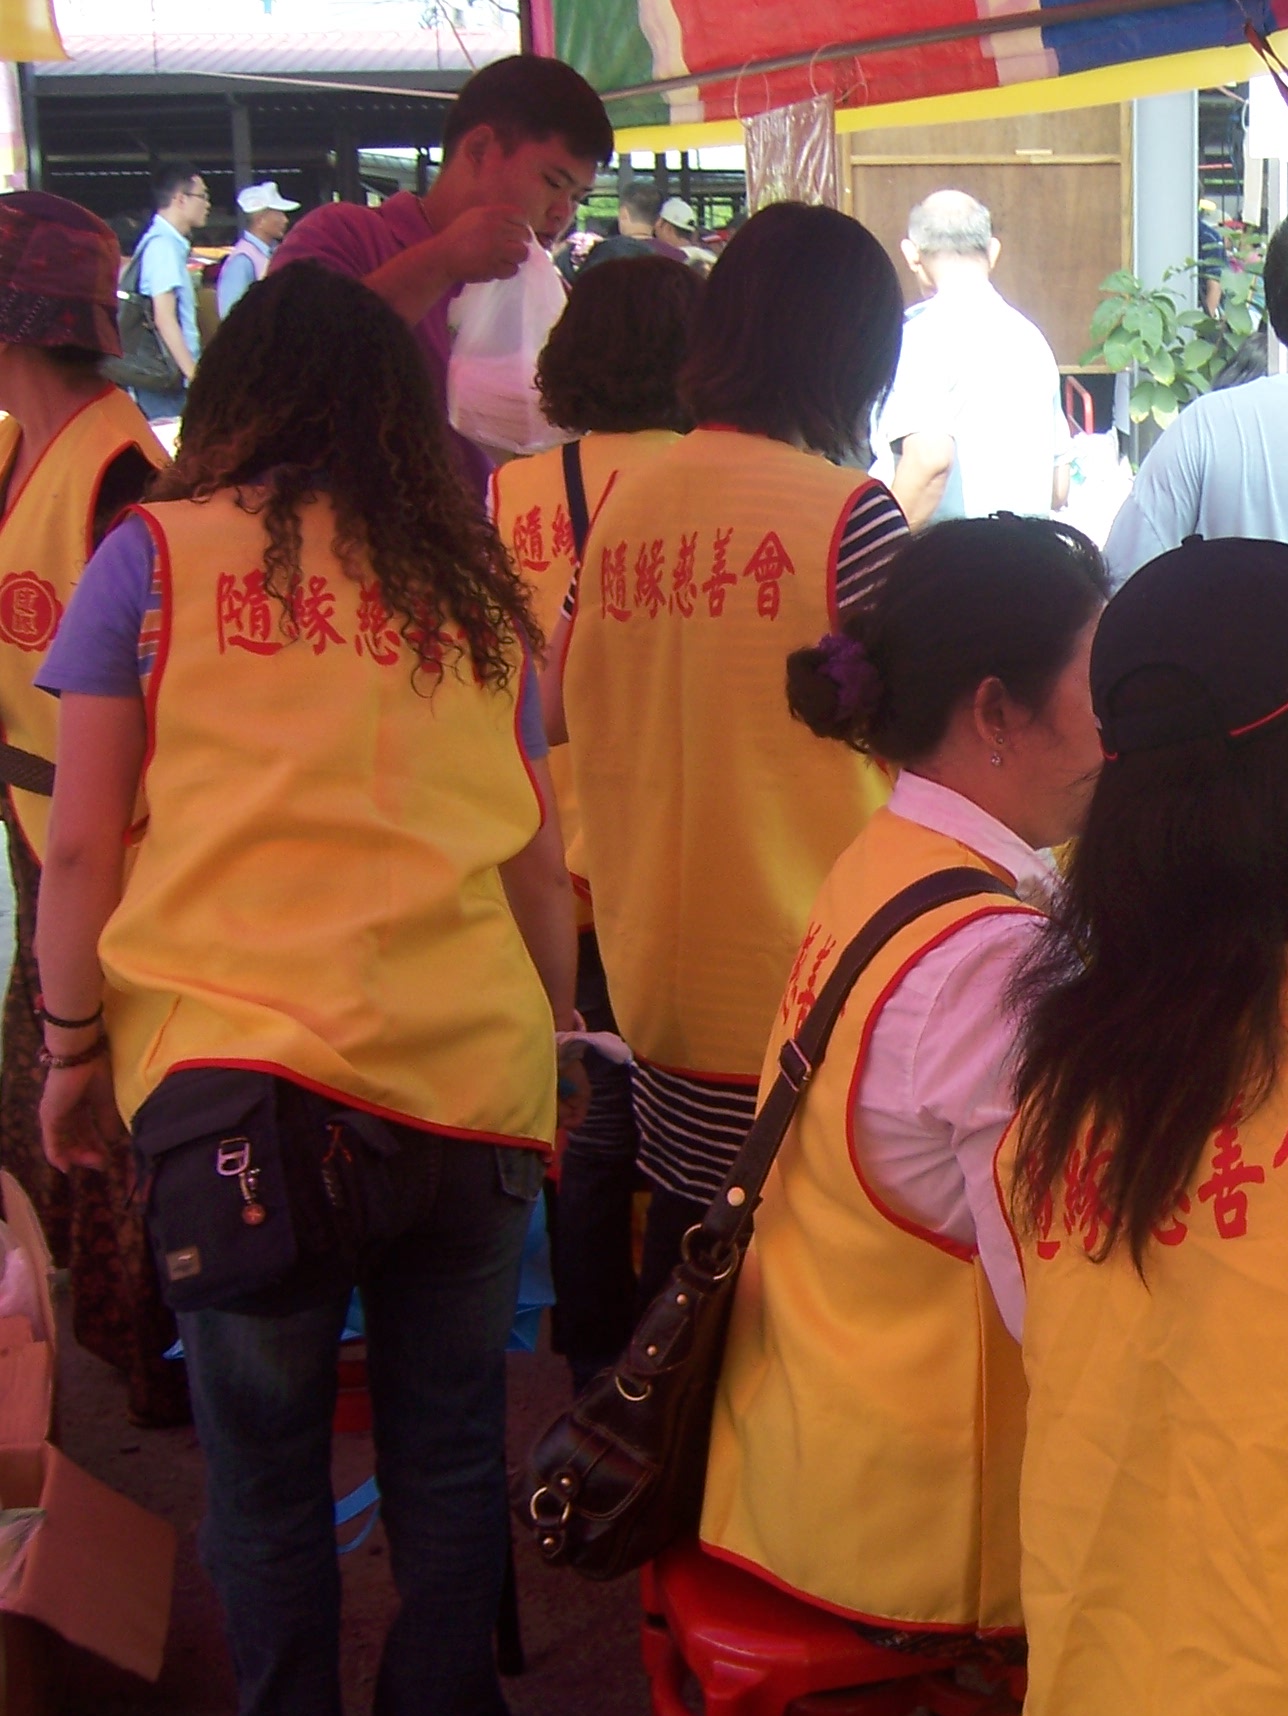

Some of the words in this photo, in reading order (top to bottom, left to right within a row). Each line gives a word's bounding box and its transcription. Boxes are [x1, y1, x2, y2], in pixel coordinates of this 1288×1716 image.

[601, 527, 796, 622] 隨緣慈善會
